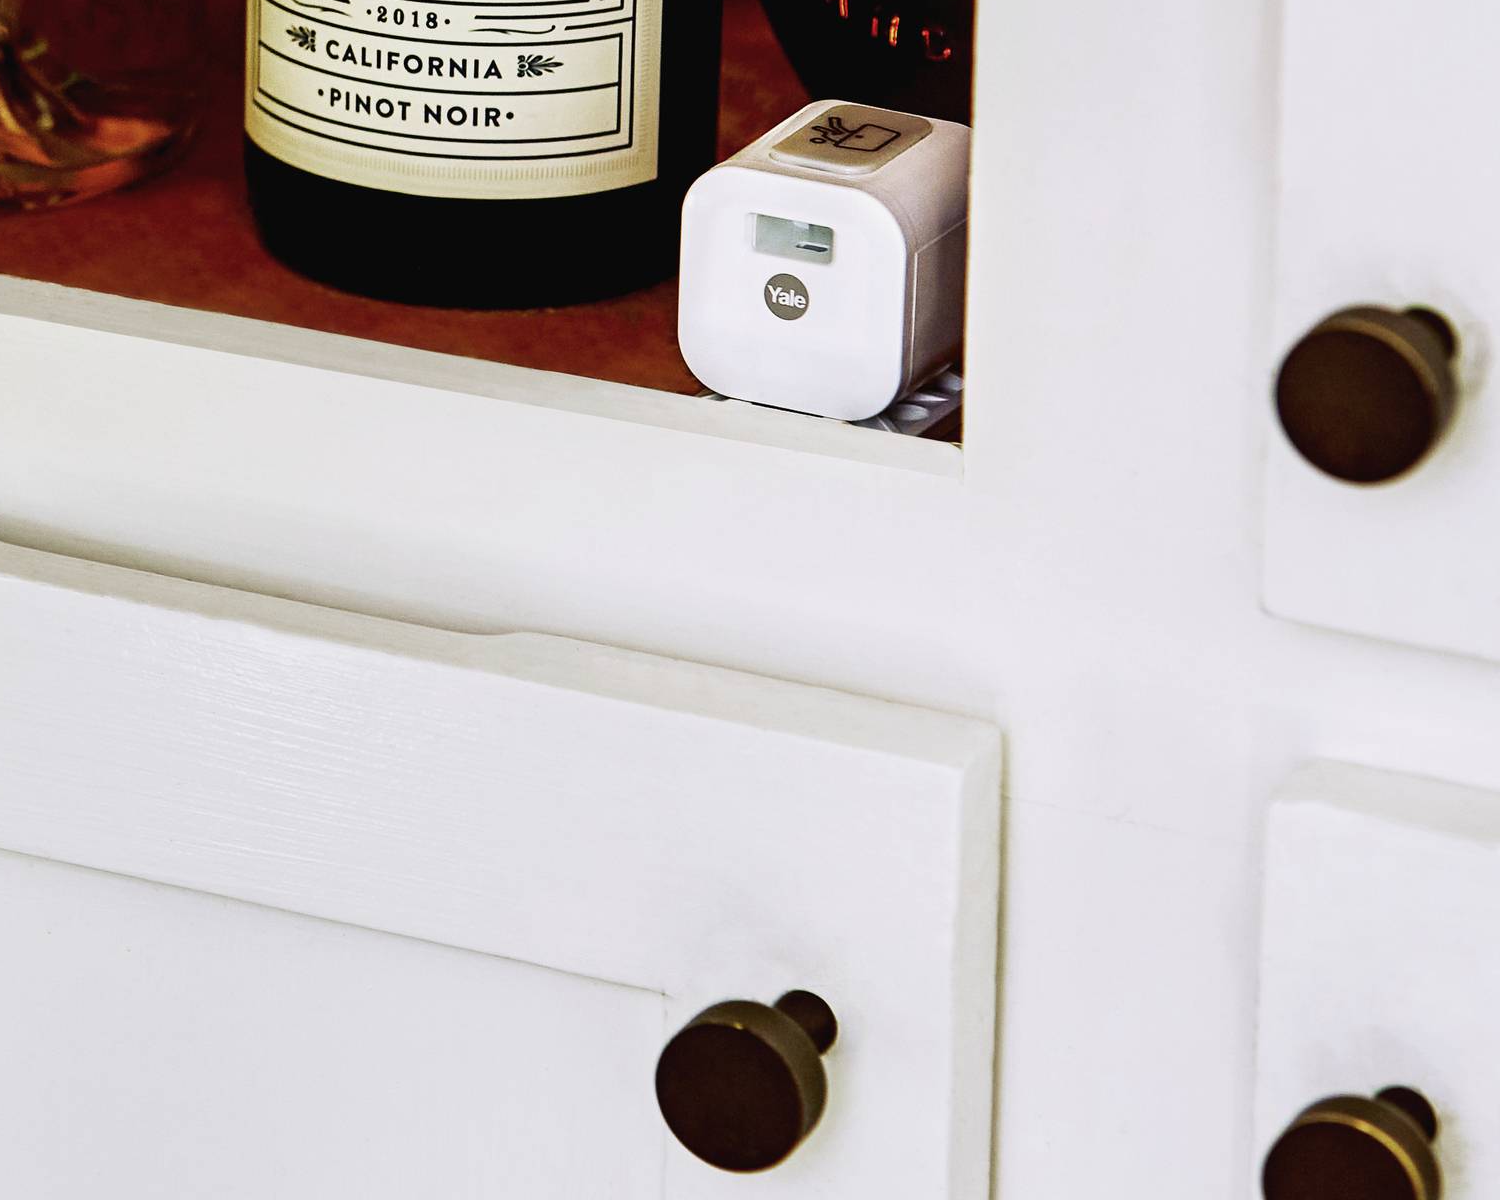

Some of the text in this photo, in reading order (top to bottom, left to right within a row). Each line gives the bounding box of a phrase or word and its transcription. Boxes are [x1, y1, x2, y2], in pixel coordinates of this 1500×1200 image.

[325, 39, 503, 80] CALIFORNIA
[329, 87, 502, 128] PINOT NOIR
[766, 284, 808, 309] Yale
